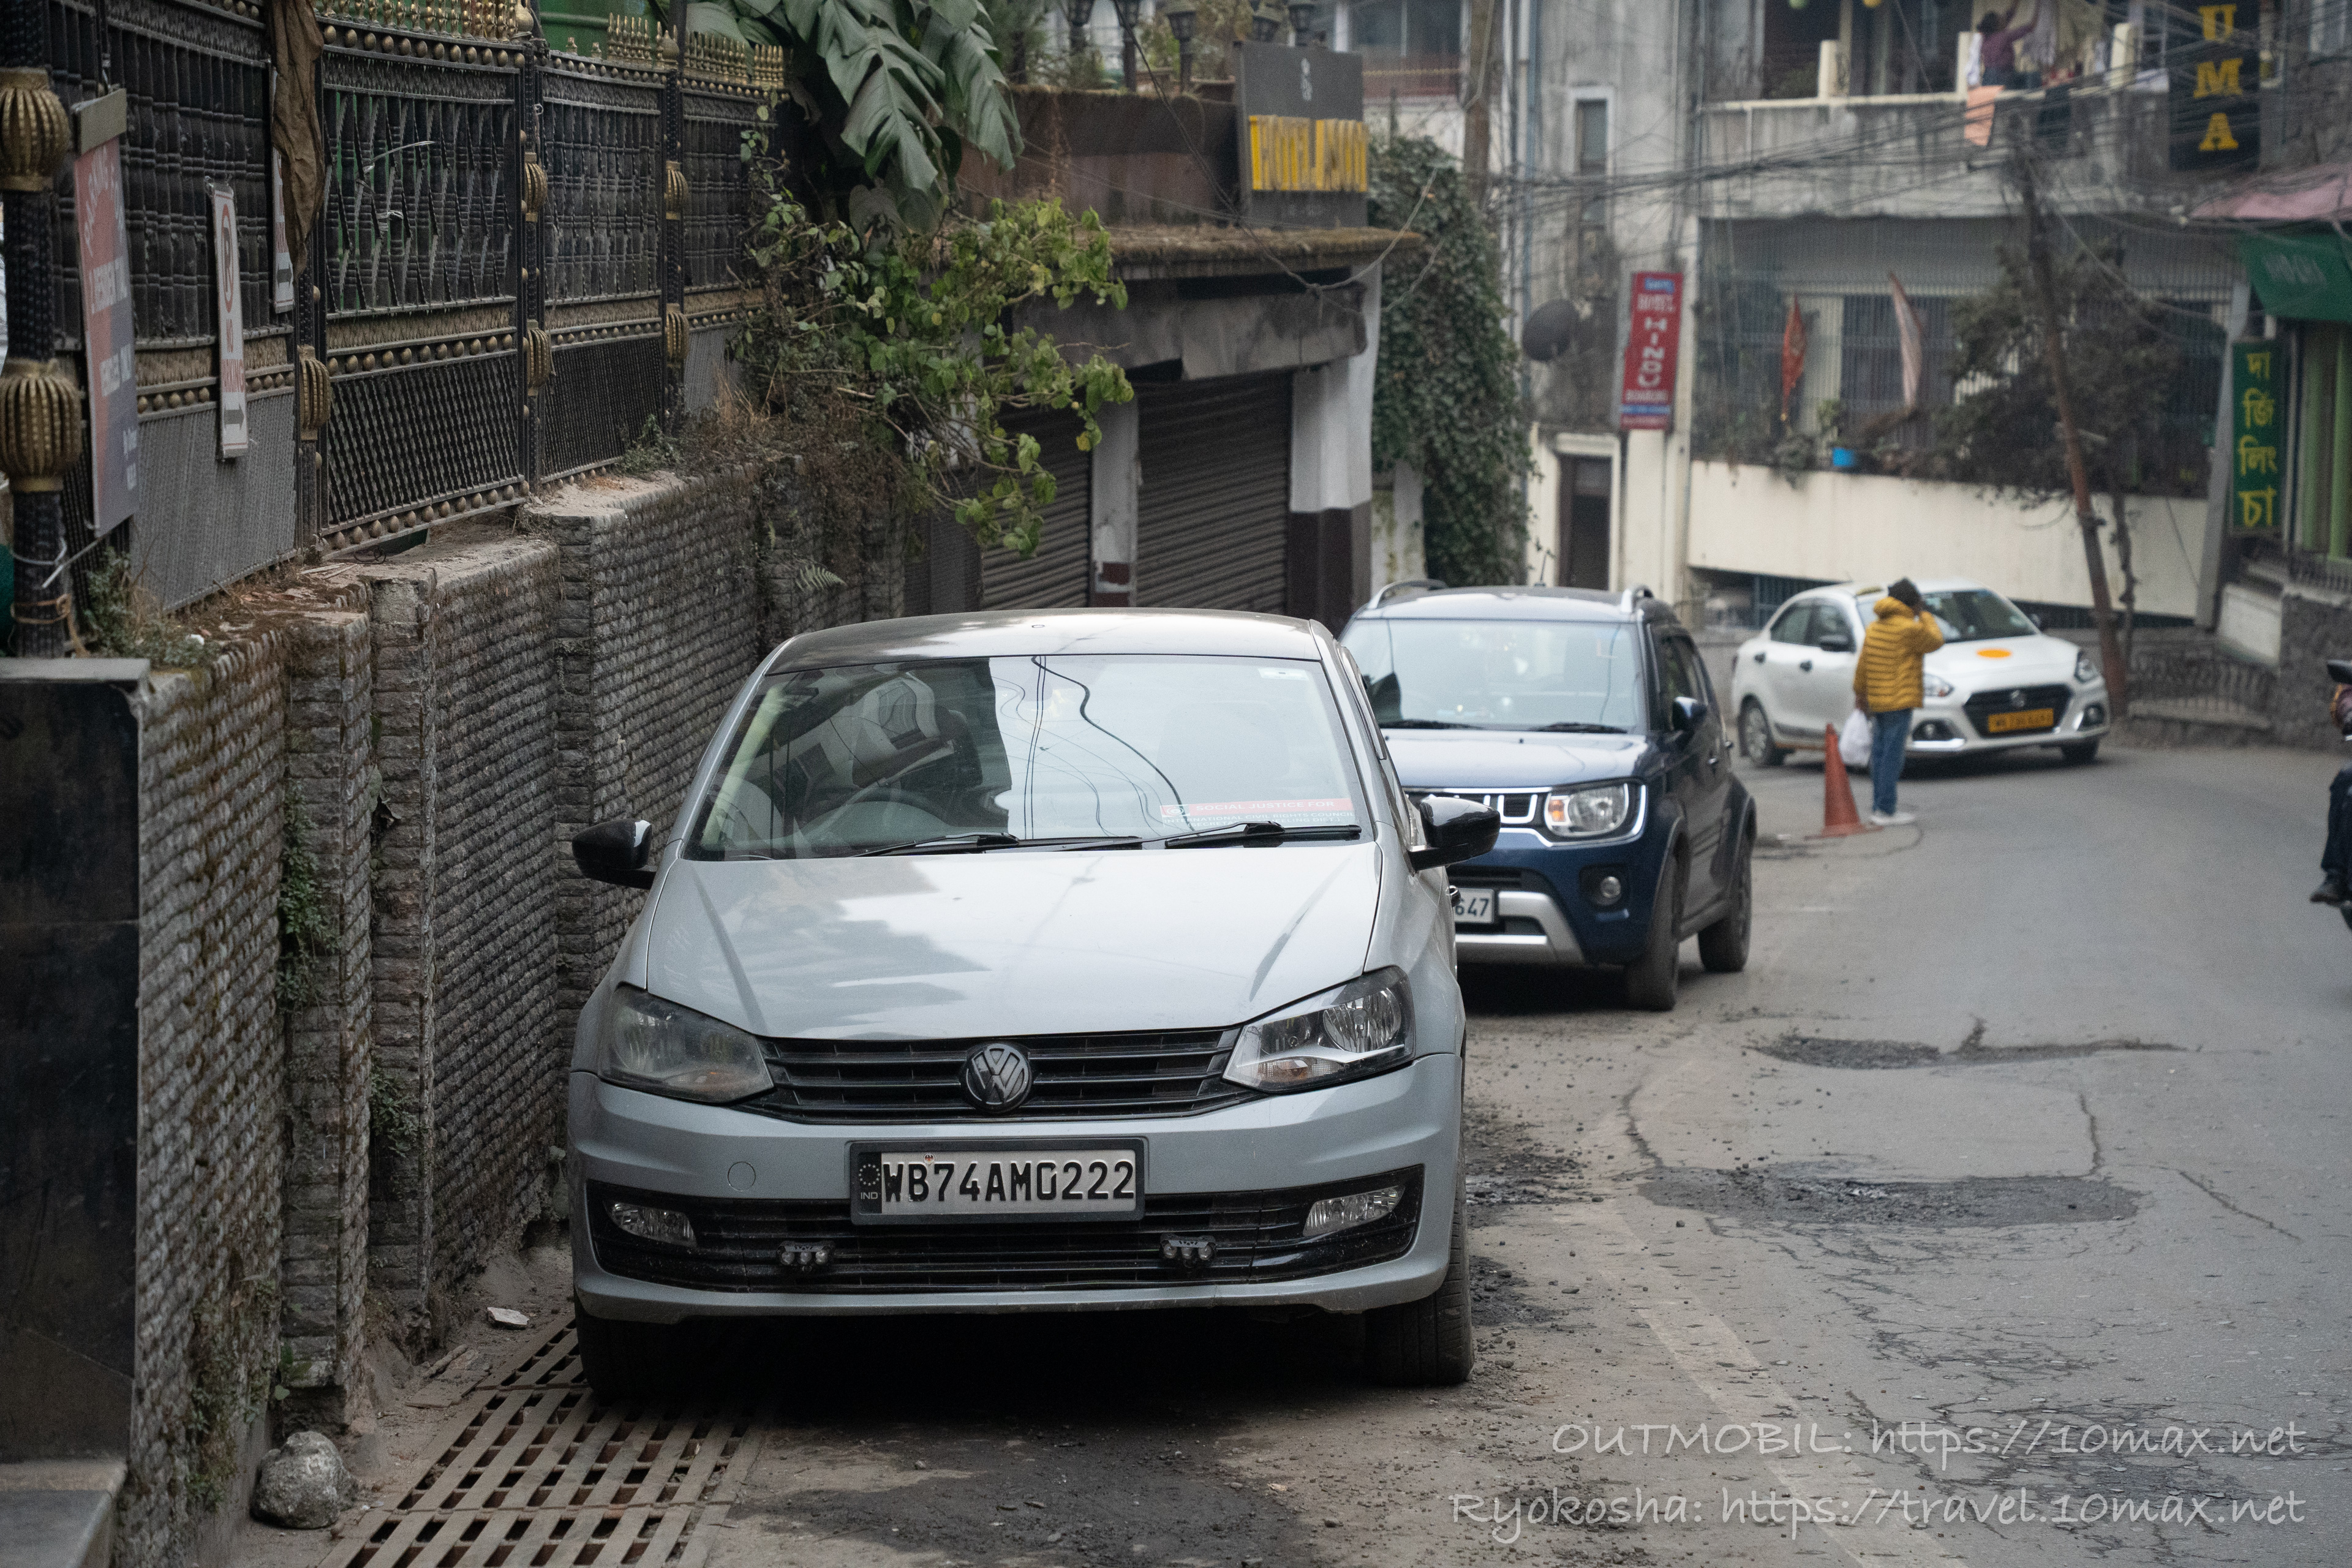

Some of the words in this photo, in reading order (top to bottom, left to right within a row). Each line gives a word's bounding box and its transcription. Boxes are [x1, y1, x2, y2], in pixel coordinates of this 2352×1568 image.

[226, 318, 234, 353] NO
[861, 1191, 878, 1200] IND
[883, 1160, 1135, 1202] WB74AM0222
